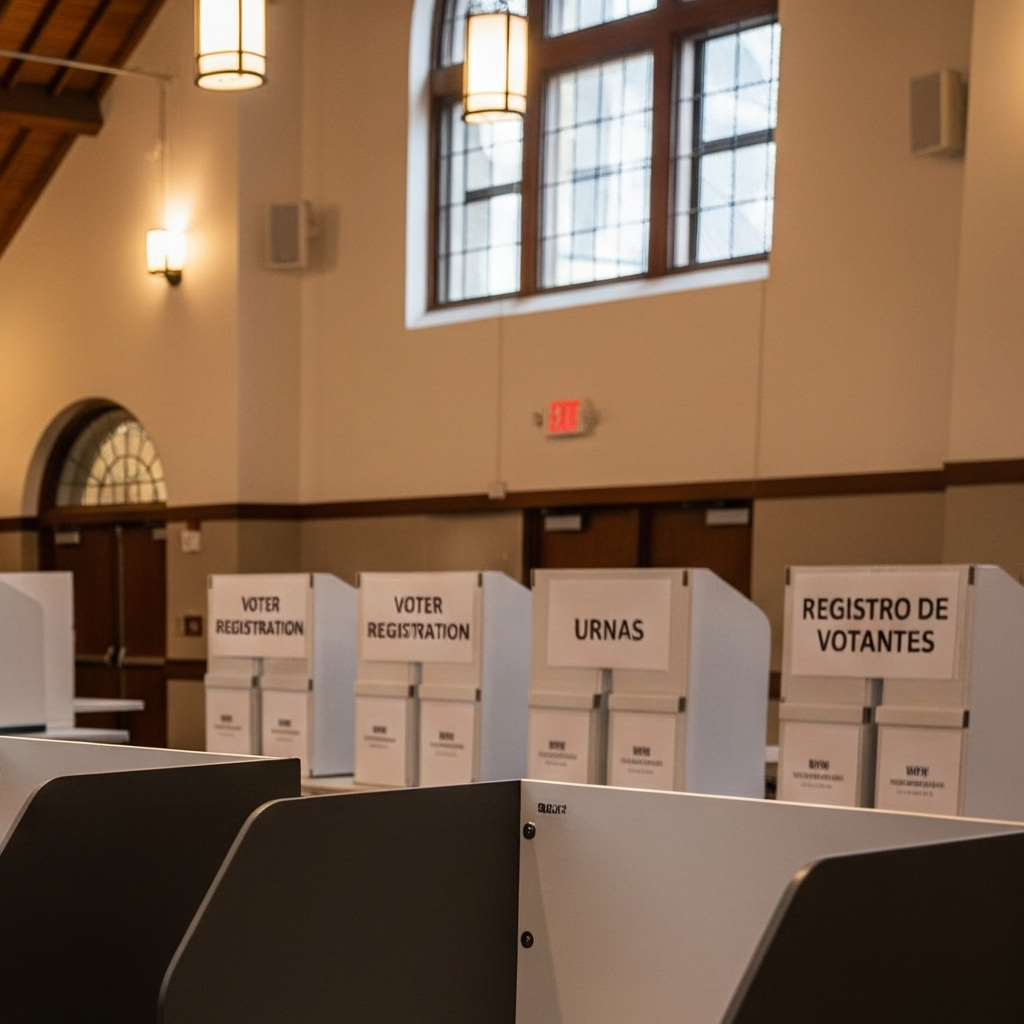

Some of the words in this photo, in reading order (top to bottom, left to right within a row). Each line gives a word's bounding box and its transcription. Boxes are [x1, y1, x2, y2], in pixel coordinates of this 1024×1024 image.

[242, 596, 280, 612] VOTER
[394, 596, 443, 614] VOTER
[802, 597, 912, 621] REGISTRO
[918, 597, 949, 621] DE
[216, 620, 304, 636] REGISTRATION
[367, 622, 470, 640] REGISTRATION
[574, 618, 645, 641] URNAS
[816, 629, 935, 653] VOTANTES
